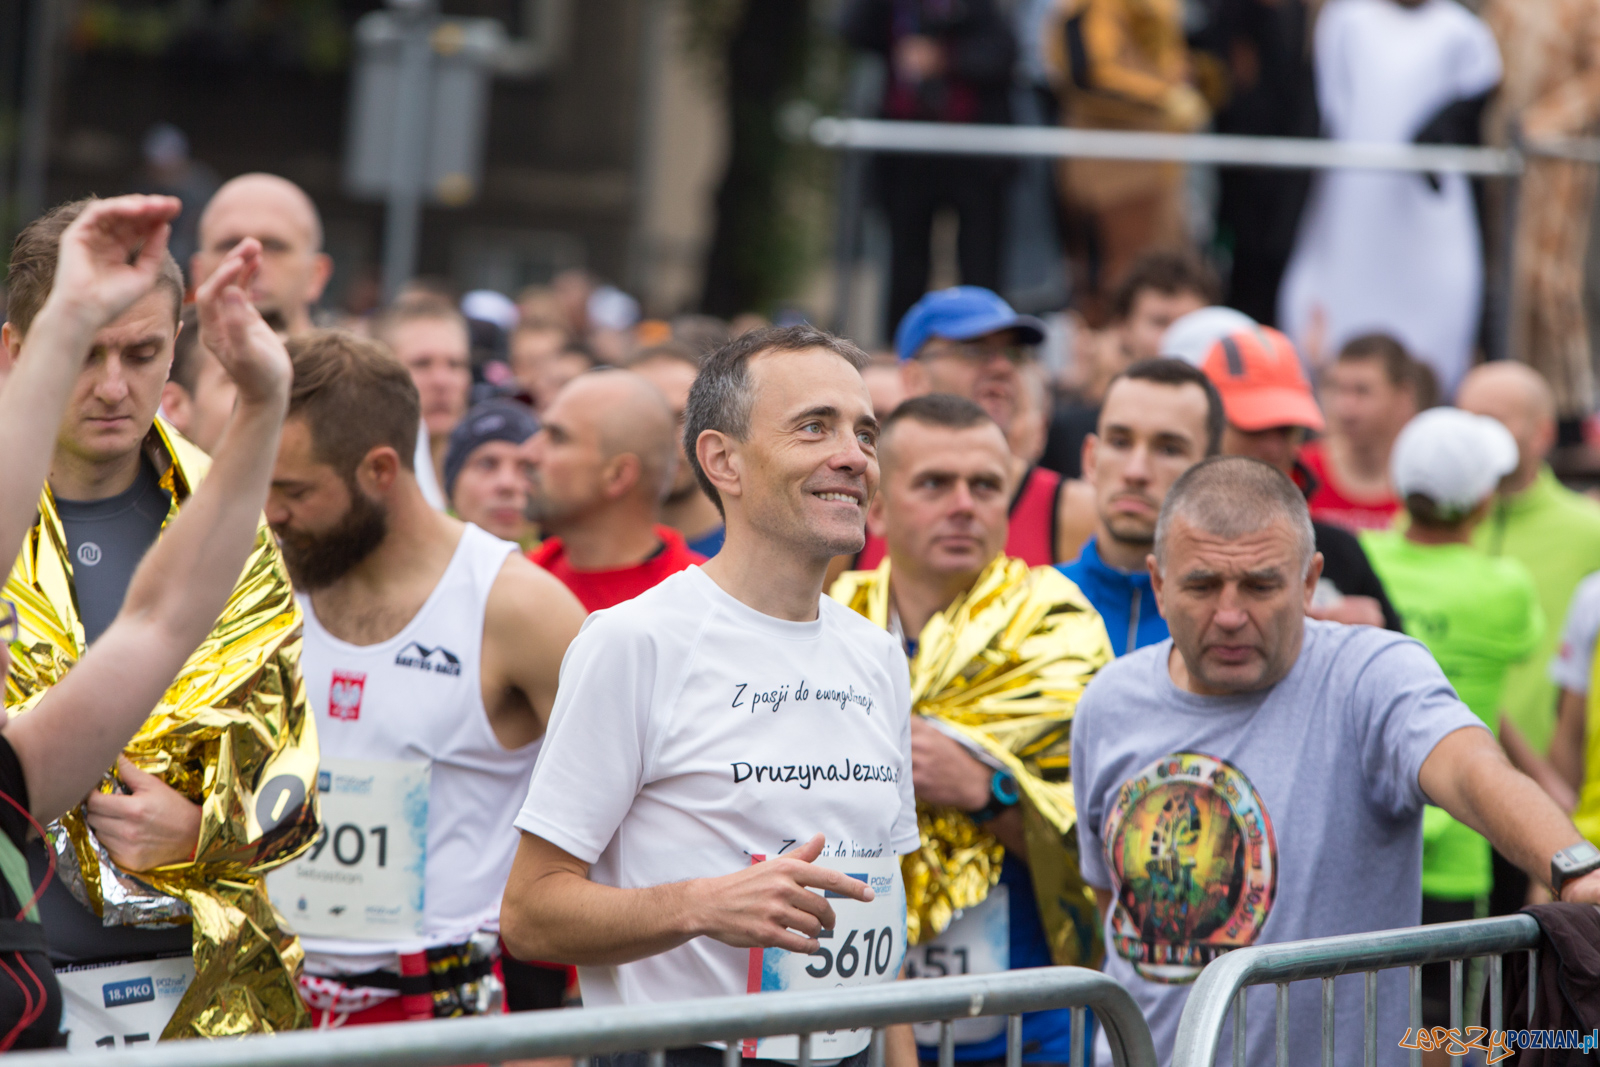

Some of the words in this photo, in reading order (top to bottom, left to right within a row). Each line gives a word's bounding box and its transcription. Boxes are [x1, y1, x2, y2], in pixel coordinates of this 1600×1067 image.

[732, 683, 748, 708] Z
[752, 685, 790, 713] pasji
[795, 680, 809, 701] do
[805, 926, 893, 978] 5610
[904, 946, 971, 979] 51
[107, 988, 125, 1001] 18.
[126, 983, 151, 998] PKO
